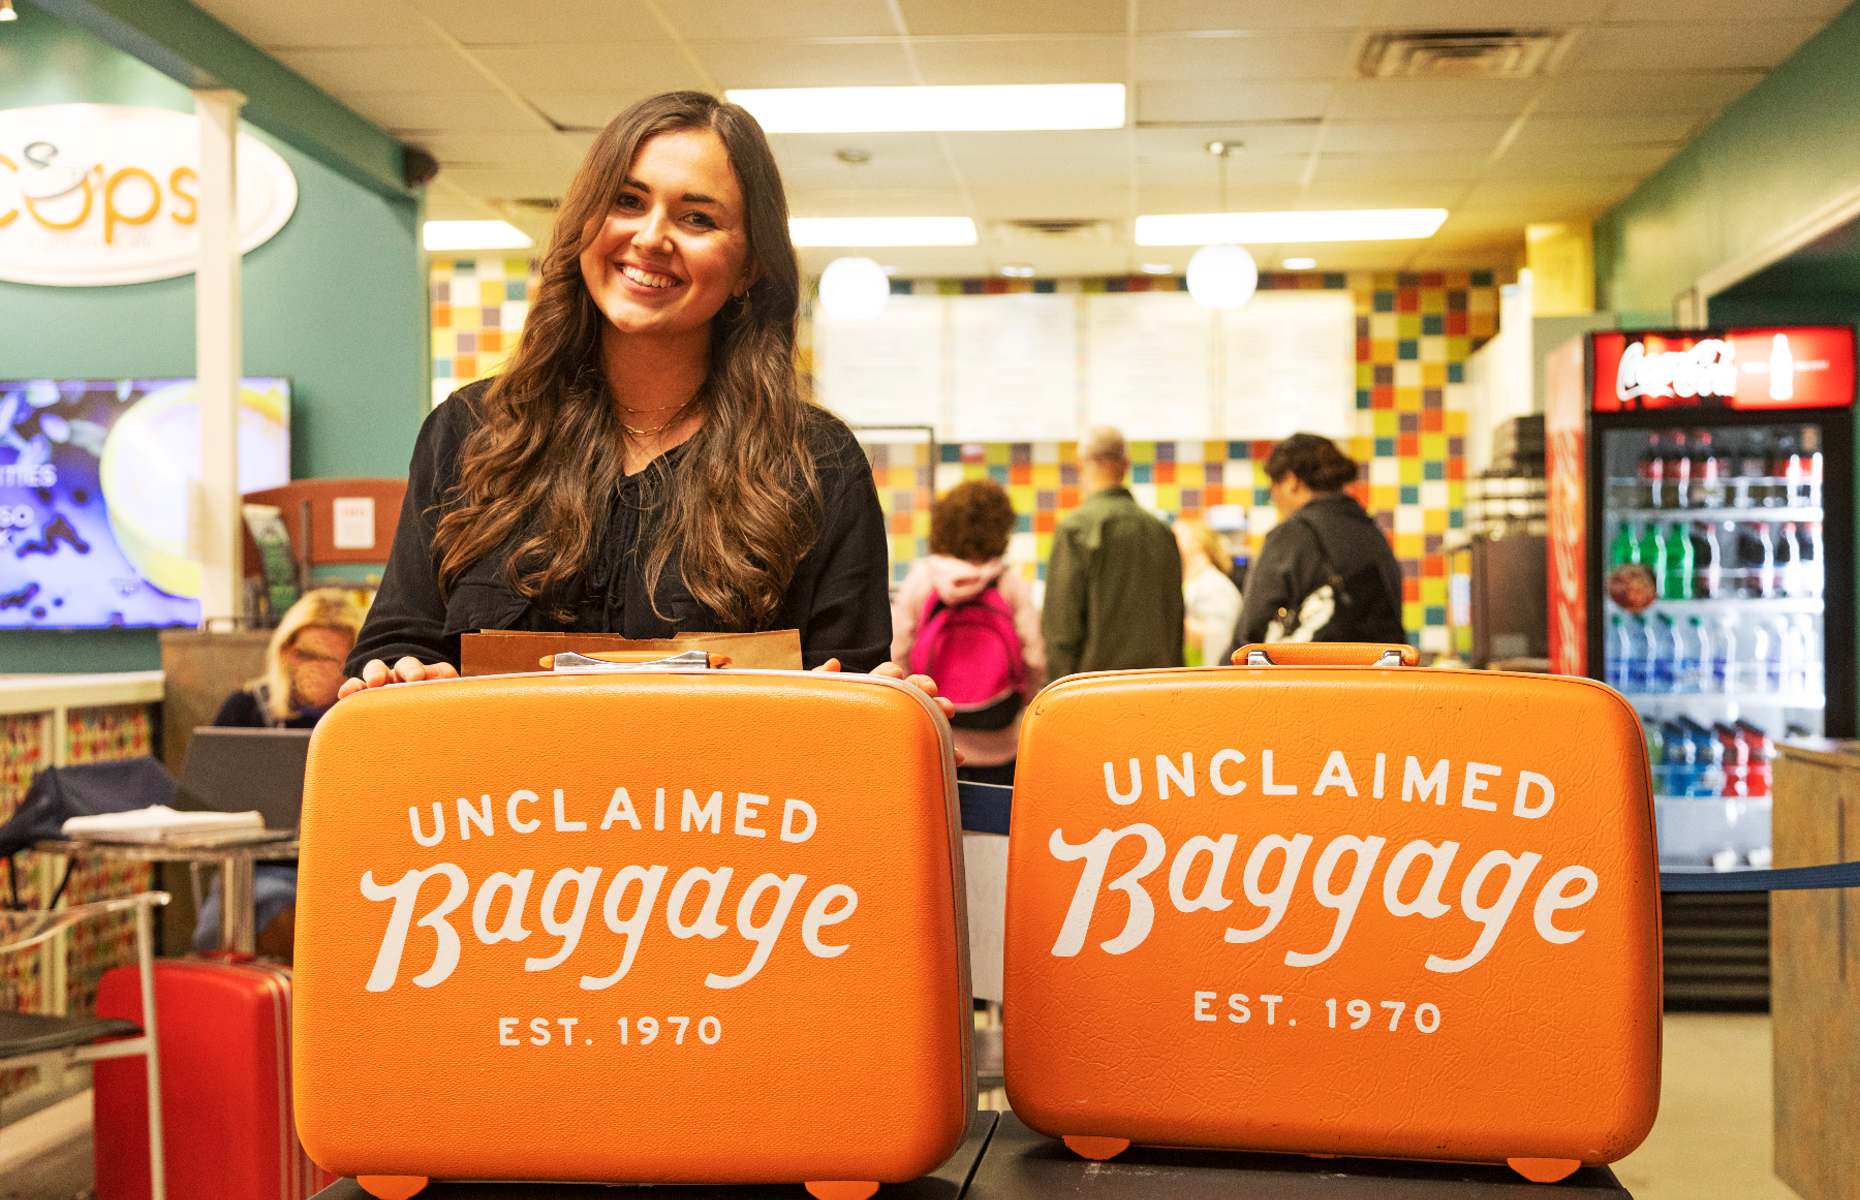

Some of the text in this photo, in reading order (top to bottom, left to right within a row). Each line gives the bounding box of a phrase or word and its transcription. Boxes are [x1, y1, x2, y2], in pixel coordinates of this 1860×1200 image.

[1103, 748, 1555, 819] UNCLAIMED
[408, 787, 817, 848] UNCLAIMED
[360, 862, 858, 993] Baggage
[1049, 822, 1599, 973] Baggage
[499, 1016, 721, 1047] EST. 1970
[1194, 991, 1441, 1034] EST. 1970
